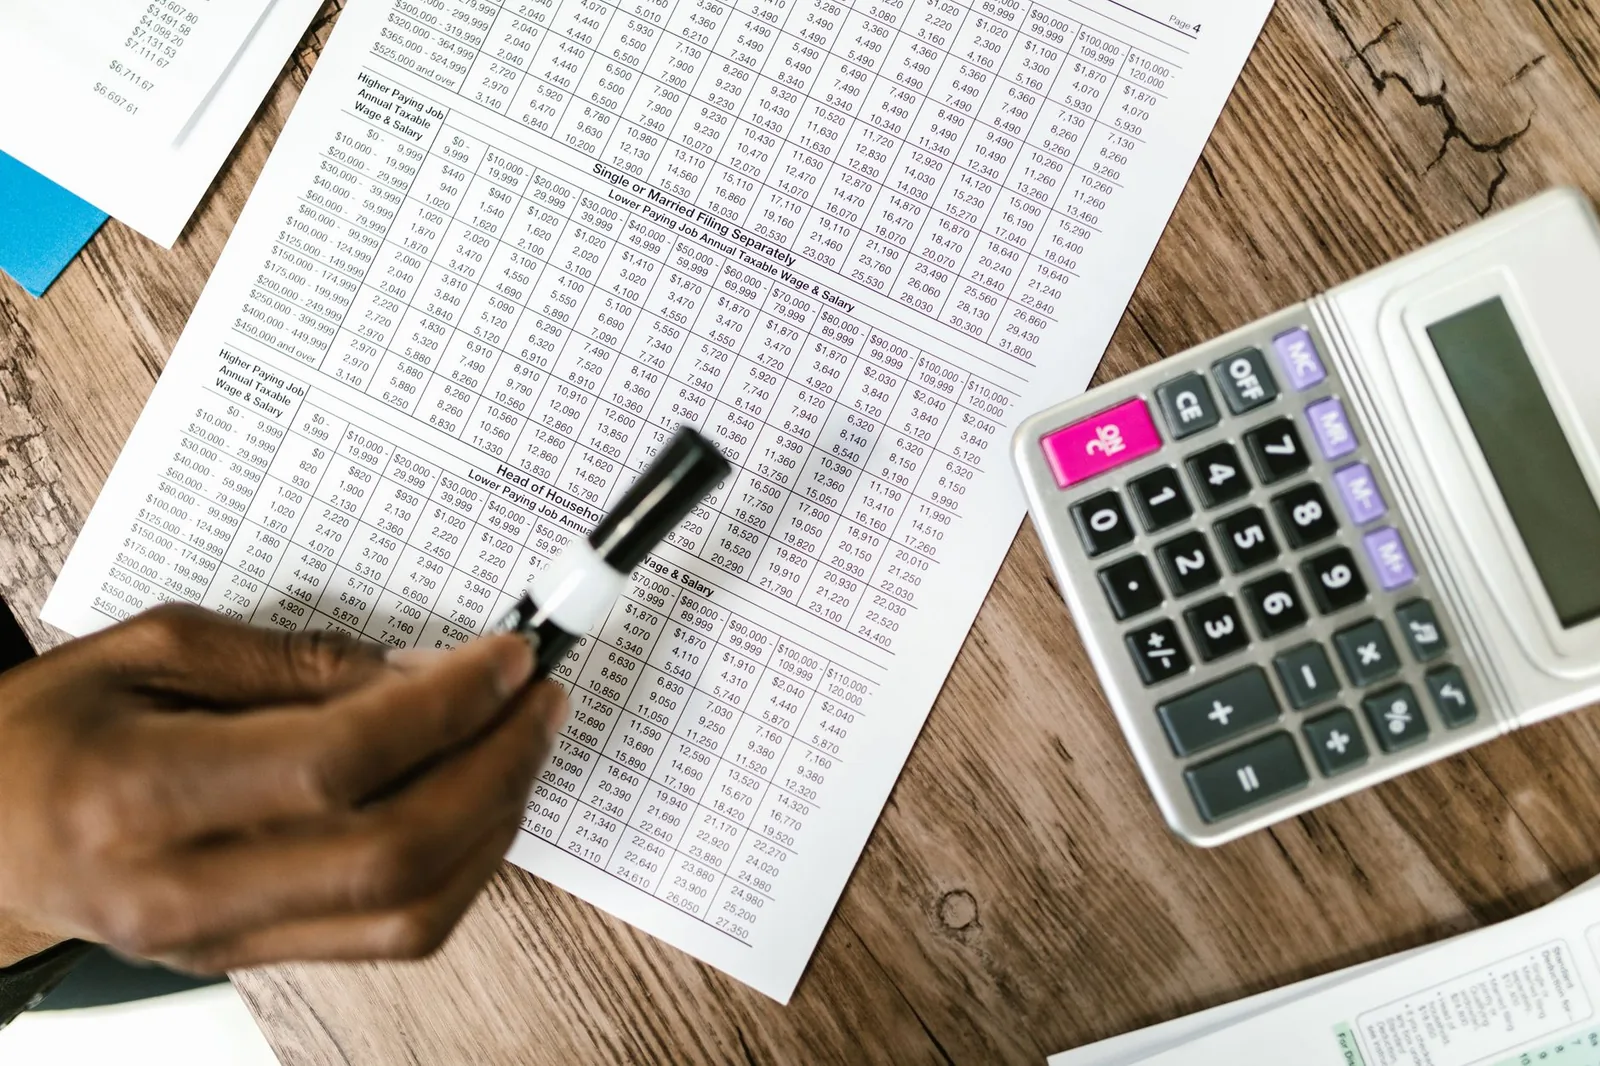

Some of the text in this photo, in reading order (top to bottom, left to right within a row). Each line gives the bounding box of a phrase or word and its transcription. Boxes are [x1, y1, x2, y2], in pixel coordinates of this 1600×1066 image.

[133, 27, 177, 59] $7,131.53
[1169, 15, 1201, 33] Page 4
[126, 38, 170, 69] $7,111.67
[1078, 31, 1170, 78] $100,000 $110,000
[1080, 45, 1165, 89] 109,999 120,000
[110, 61, 154, 92] $6,711.67
[357, 72, 444, 120] Higher Paying Job
[1073, 63, 1157, 106] $1,870 $1,870
[355, 100, 423, 142] Wage & Salary
[357, 88, 431, 129] Annual Taxable
[373, 41, 1033, 360] $525,000 and over 3,140 6,840 10,200 12,900 15,530 18,030 20,530 23,030 25,530 28,030 30,300 31,800
[592, 163, 797, 267] Single or Married Filing Separately
[452, 136, 1009, 406] $0 $10,000 $20,000 $30,000 $40,000 $50,000 $60,000 $70,000 $80,000 $90,000 $100,000 $110,000
[608, 188, 855, 313] Lower Paying Job Annual Taxable Wage & Salary
[366, 129, 996, 435] $0 9,999 $440 $940 $1,020 $1,020 $1,410 $1,870 $1,870 $1,870 $1,870 $2,030 $2,040 $2,040
[443, 145, 1004, 418] 9,999 19,999 29,999 39,999 49,999 59,999 69,999 79,999 89,999 99,999 109,999 120,000
[234, 318, 316, 363] $450,000 and over
[1288, 342, 1316, 376] MC
[218, 348, 305, 397] Higher Paying Job
[218, 365, 291, 406] Annual Taxable
[1231, 359, 1264, 402] OFF
[215, 377, 284, 419] Wage & Salary
[1176, 392, 1203, 422] CE
[1103, 424, 1126, 456] ON
[1265, 434, 1295, 454] 7
[1321, 412, 1347, 445] MR
[496, 464, 604, 524] Head of Househol
[1209, 463, 1235, 485] 4
[1149, 487, 1175, 505] 1
[1293, 500, 1322, 525] 8
[467, 468, 502, 491] Lower
[501, 485, 537, 511] Paying
[537, 504, 558, 520] Job
[559, 515, 594, 537] Annua
[670, 569, 679, 581] &
[680, 574, 715, 598] Salary
[1090, 509, 1118, 531] 0
[1234, 525, 1264, 548] 5
[1175, 550, 1205, 575] 2
[1322, 565, 1351, 588] 9
[1263, 592, 1292, 614] 6
[1205, 615, 1234, 638] 3
[625, 603, 855, 723] $1,870 $1,870 $1,910 $2,040 $2,040
[1148, 632, 1175, 668] +/-
[1385, 700, 1411, 733] %
[574, 710, 703, 781] 12,690 13,690 14,690
